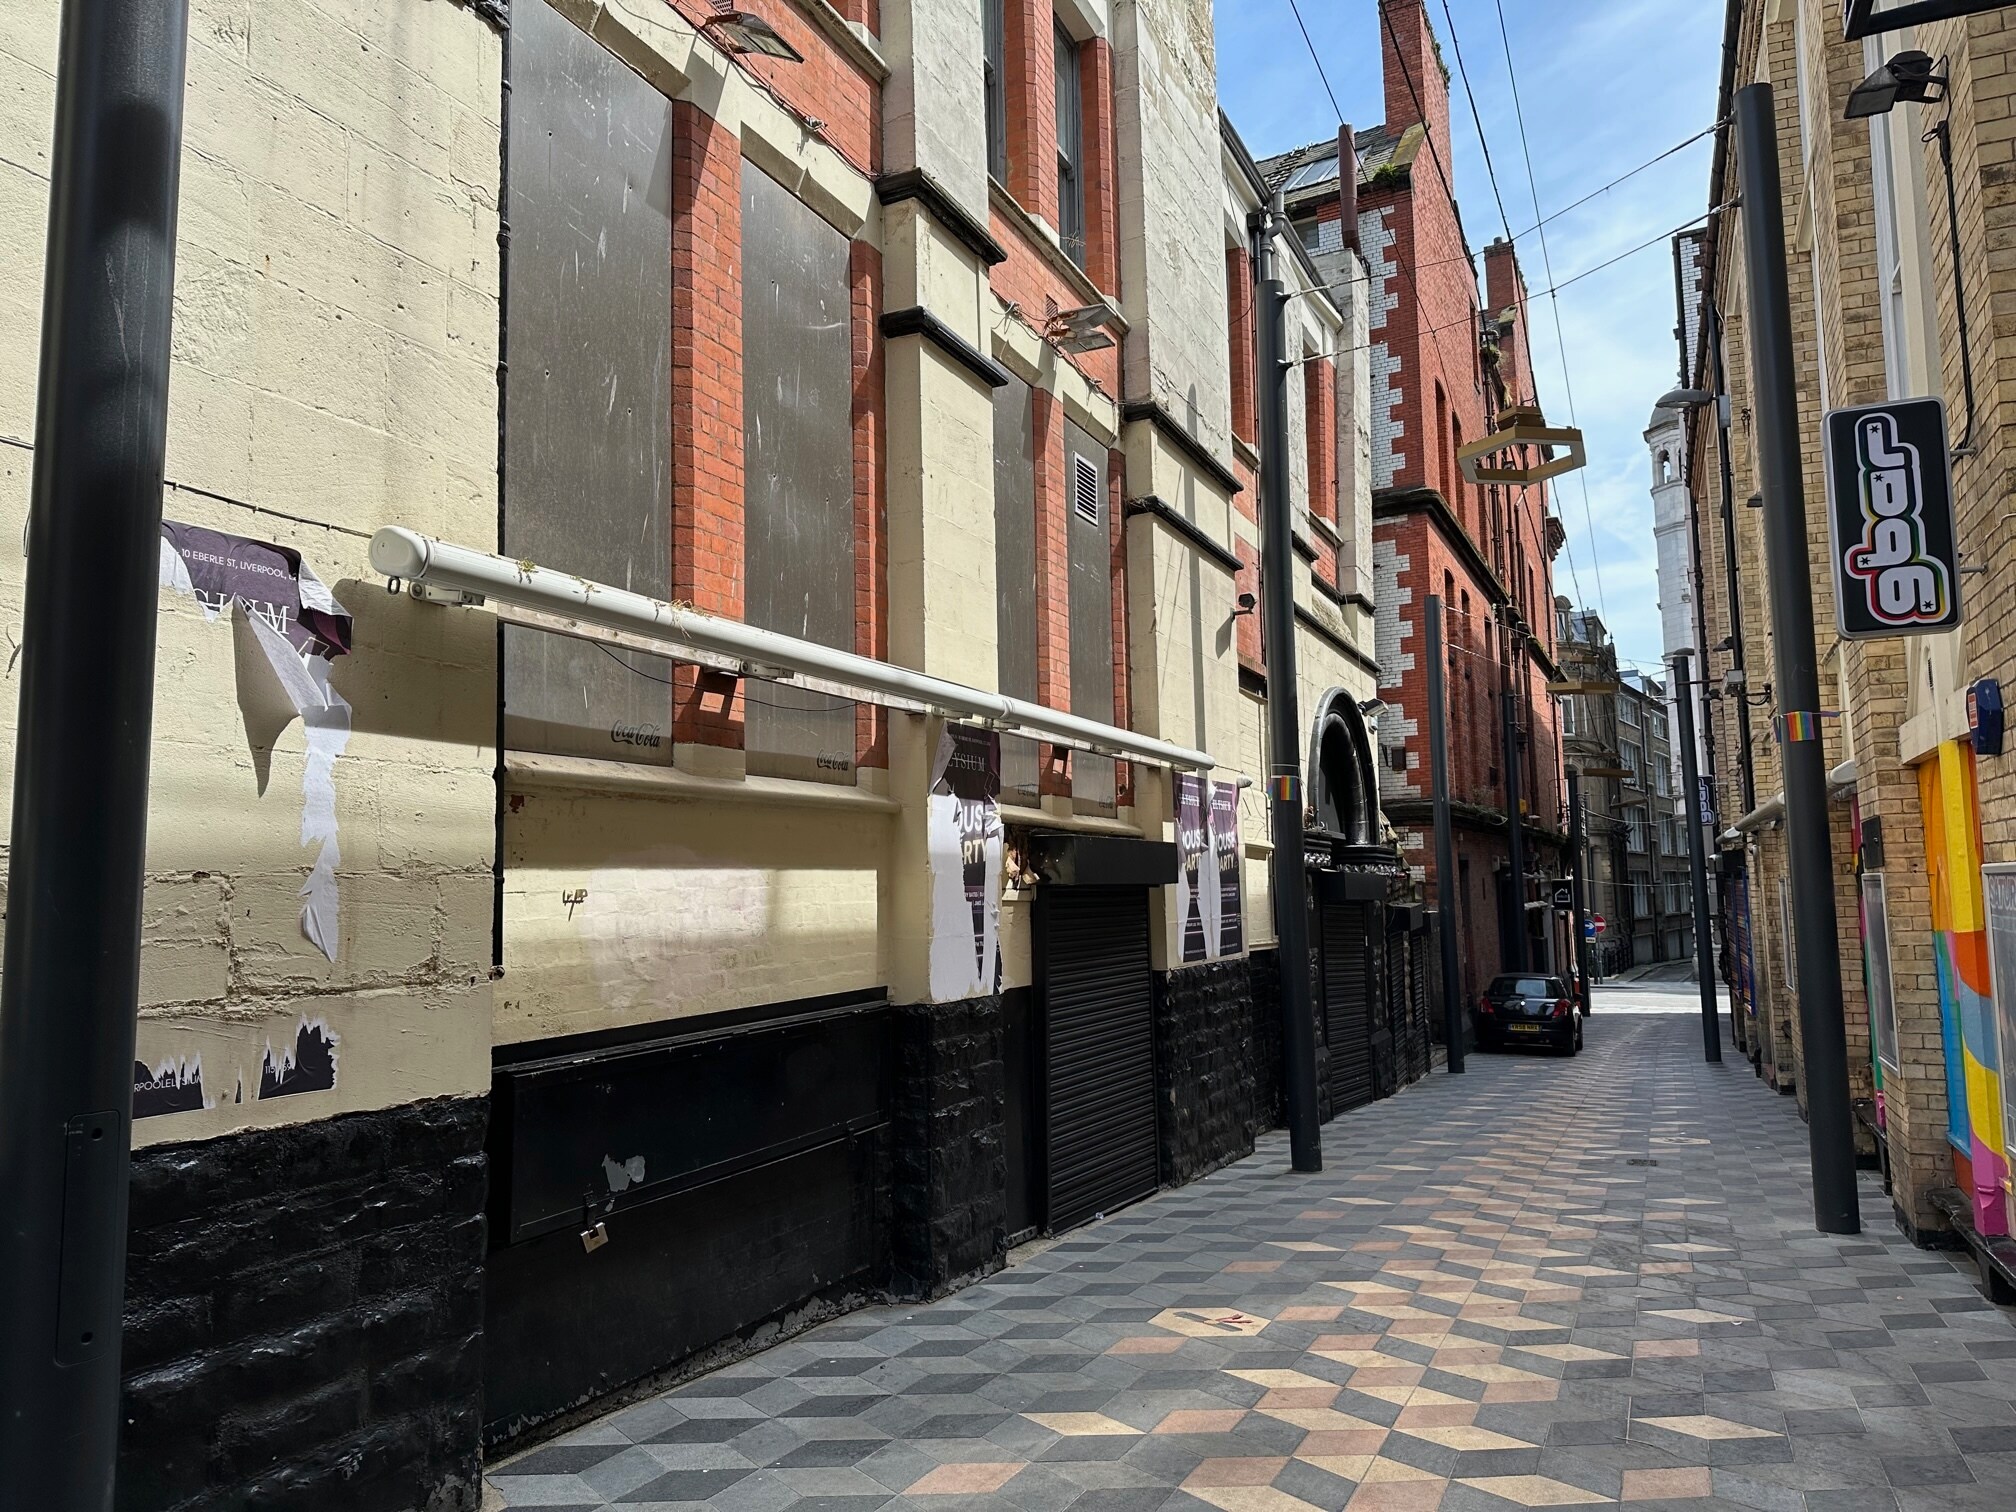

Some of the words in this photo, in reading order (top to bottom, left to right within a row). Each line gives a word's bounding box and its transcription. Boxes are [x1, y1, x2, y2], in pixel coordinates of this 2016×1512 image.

[1851, 417, 1943, 619] gbar
[181, 548, 191, 559] 10
[192, 550, 225, 566] EBERLE
[226, 557, 238, 570] ST,
[240, 561, 287, 580] LIVERPOOL,
[963, 838, 986, 865] RTY
[1219, 852, 1235, 872] ARTY
